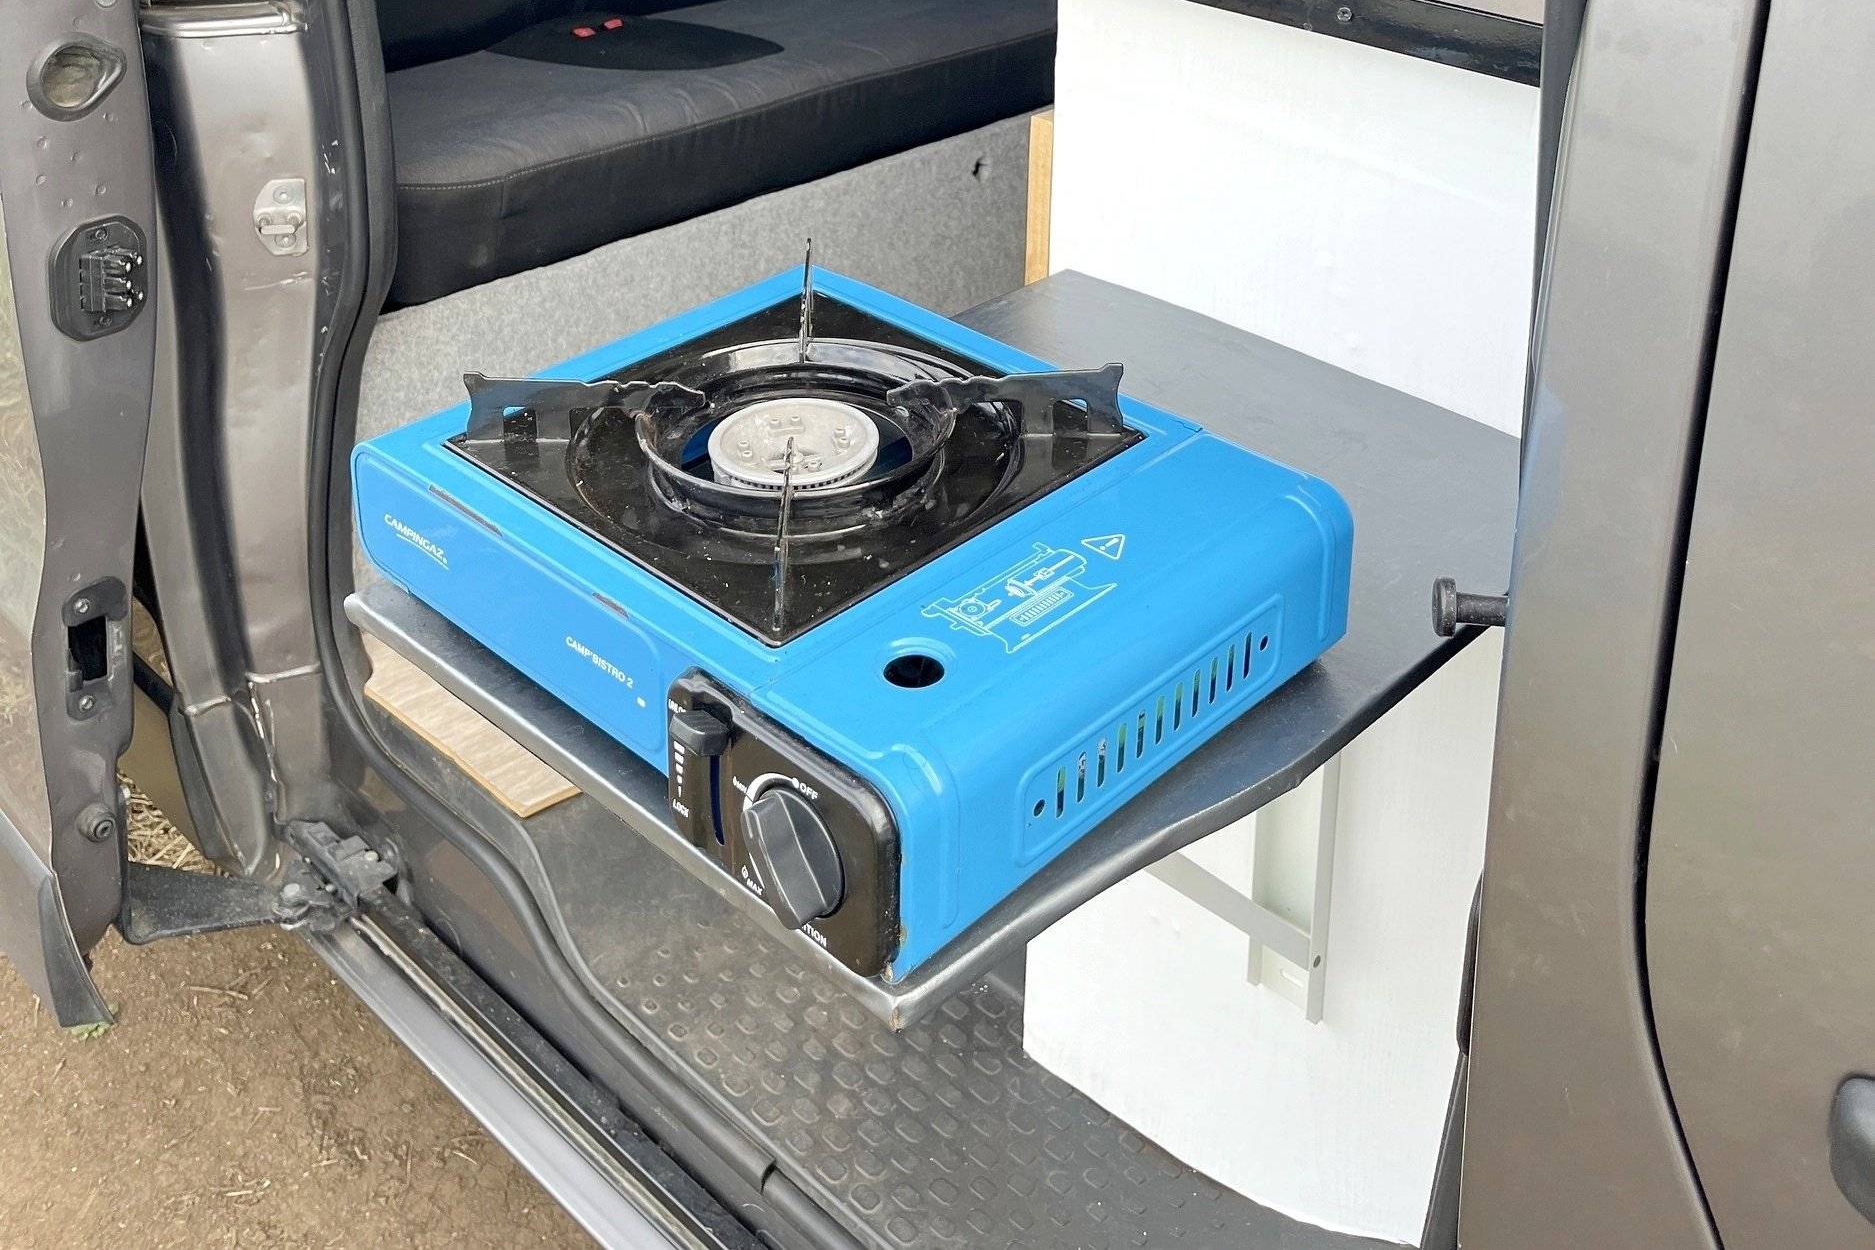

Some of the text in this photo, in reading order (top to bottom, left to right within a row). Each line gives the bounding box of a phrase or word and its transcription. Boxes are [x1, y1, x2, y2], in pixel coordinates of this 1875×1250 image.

[384, 513, 446, 562] CAMPINGAZ
[626, 676, 634, 689] 2
[799, 782, 819, 800] OFF
[672, 798, 690, 818] LOCK
[746, 878, 763, 896] MAX
